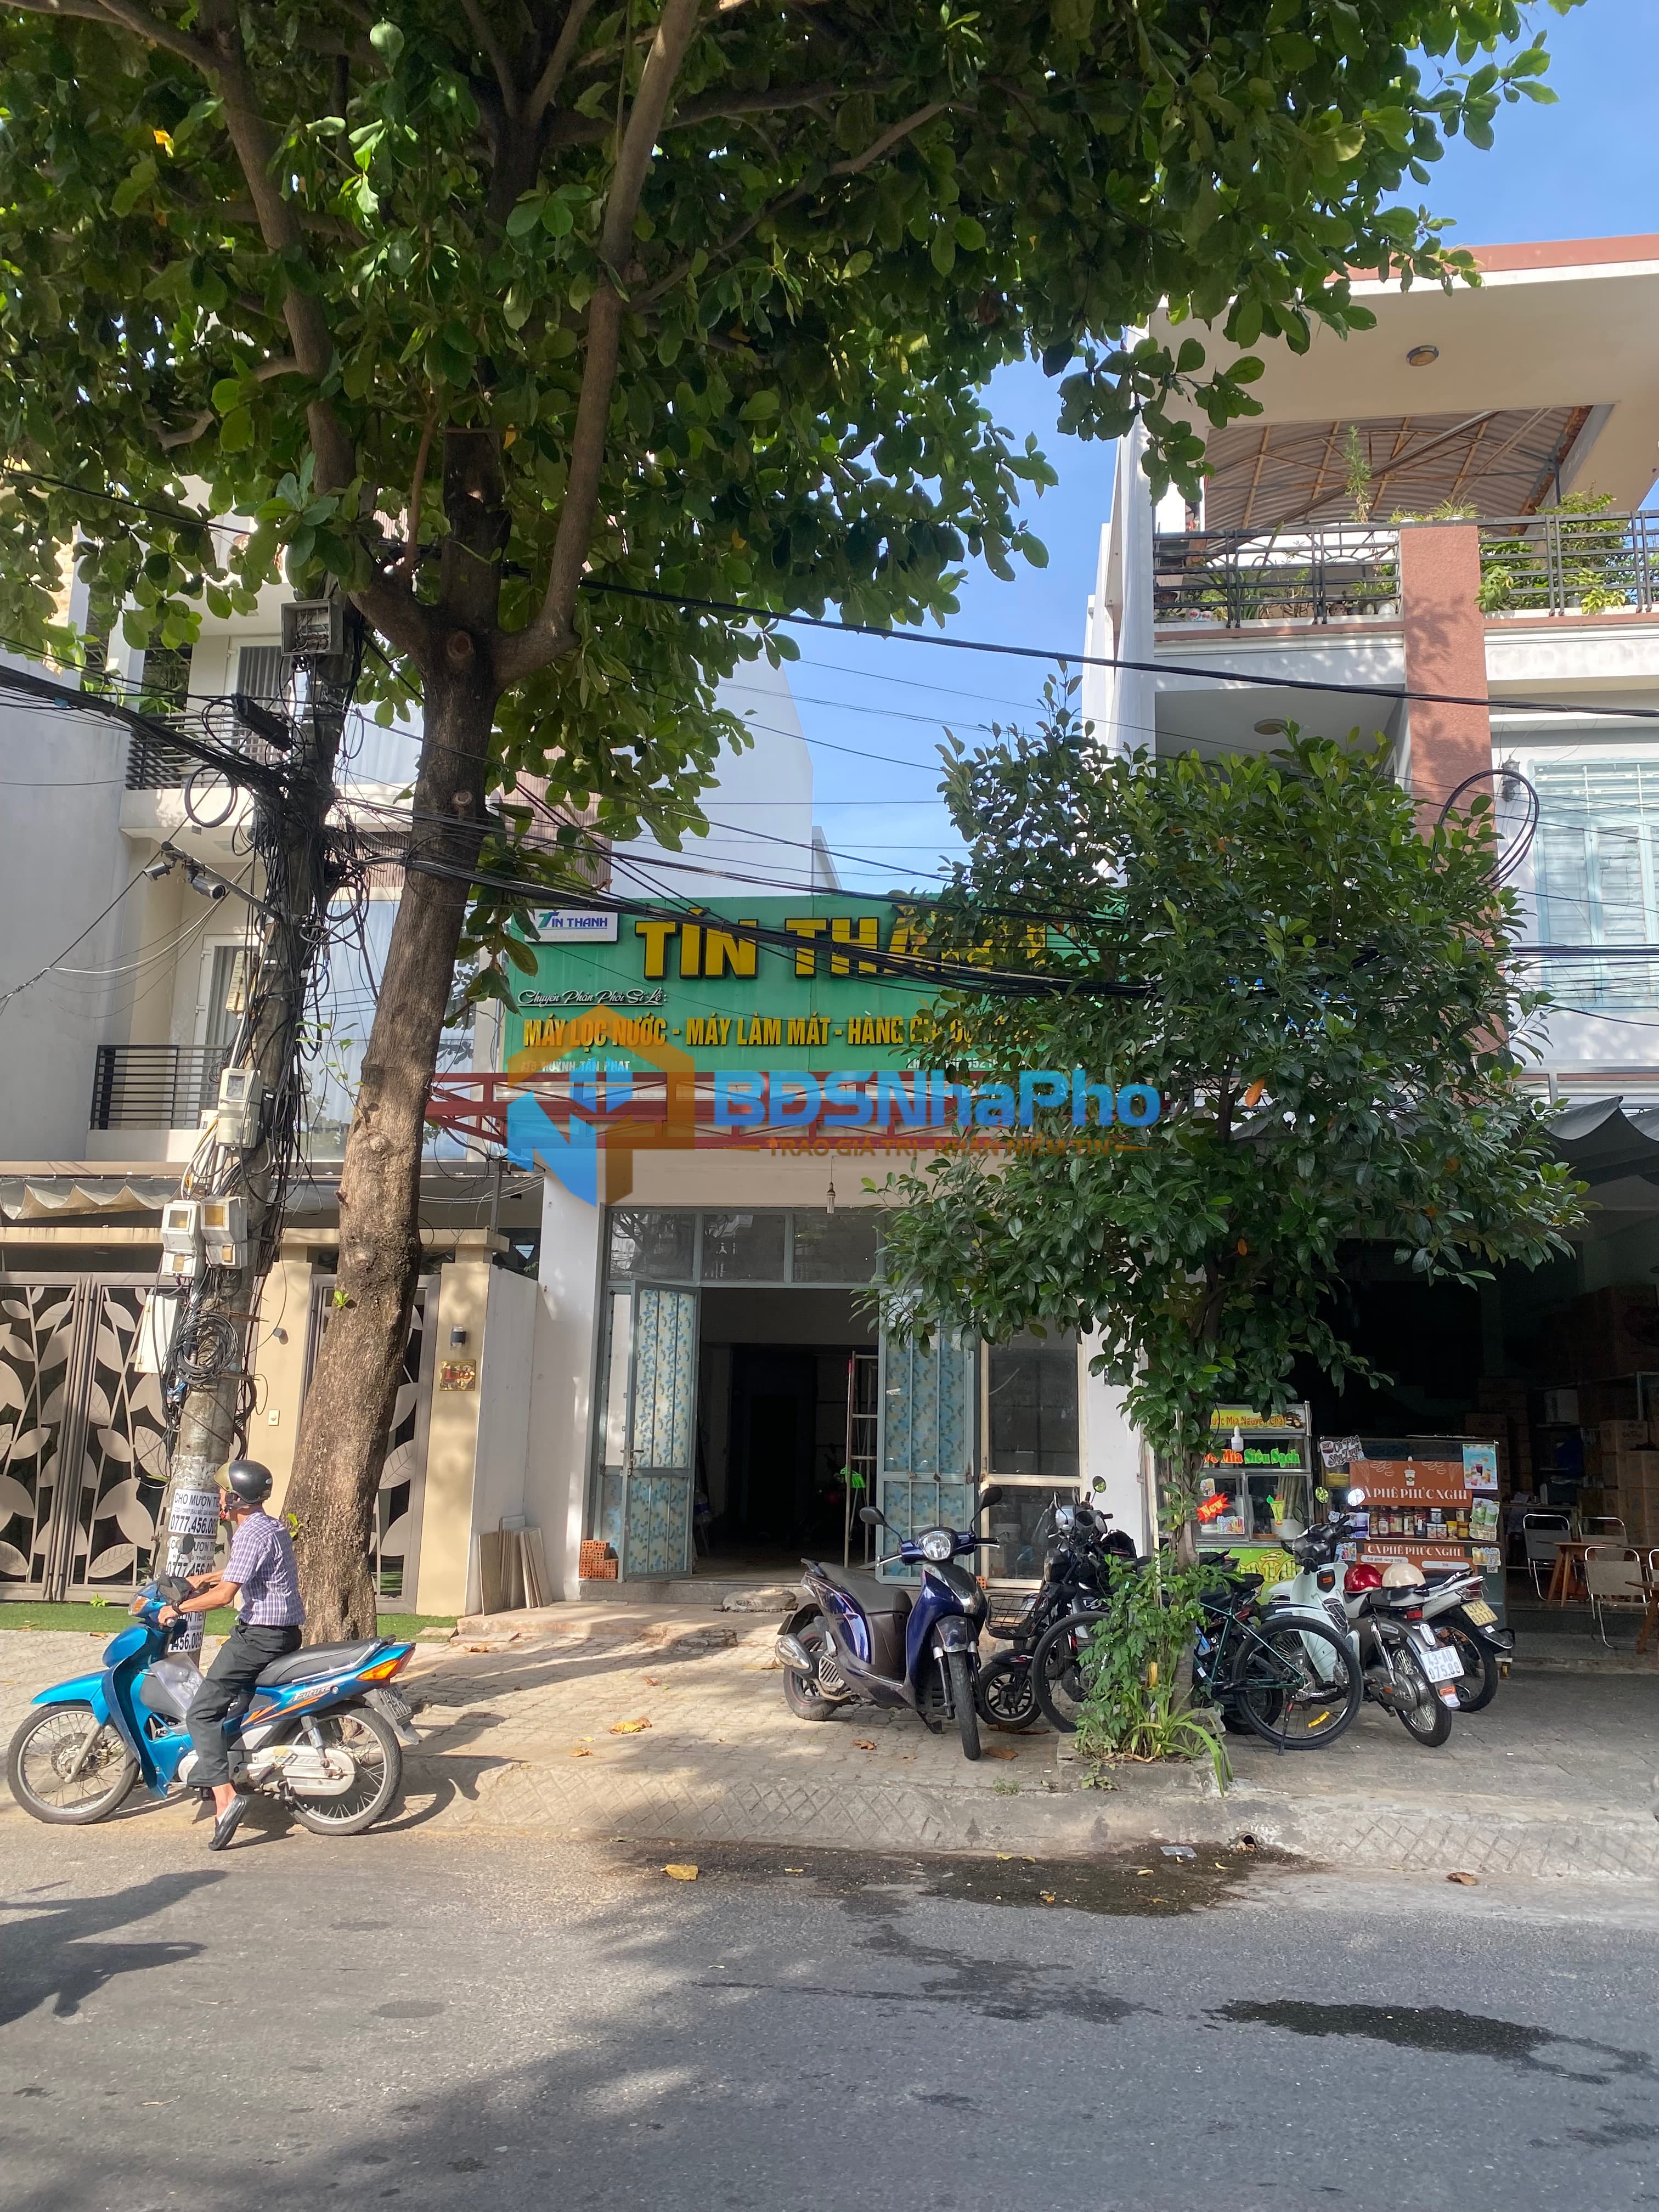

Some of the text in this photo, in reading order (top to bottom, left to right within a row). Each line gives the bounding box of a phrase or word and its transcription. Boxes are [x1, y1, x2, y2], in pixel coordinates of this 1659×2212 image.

[635, 907, 759, 979] TÍN
[523, 1013, 567, 1047] MÁY
[570, 1019, 607, 1052] LỌC
[612, 1012, 667, 1046] NƯỚC
[686, 1012, 732, 1046] MÁY
[737, 1011, 782, 1046] LÀM
[787, 1011, 831, 1046] MÁT
[848, 1010, 905, 1045] HÀNG
[1244, 1447, 1271, 1464] Siêu
[1271, 1447, 1300, 1468] Sạch
[174, 1492, 188, 1504] CHO
[1200, 1499, 1223, 1517] New
